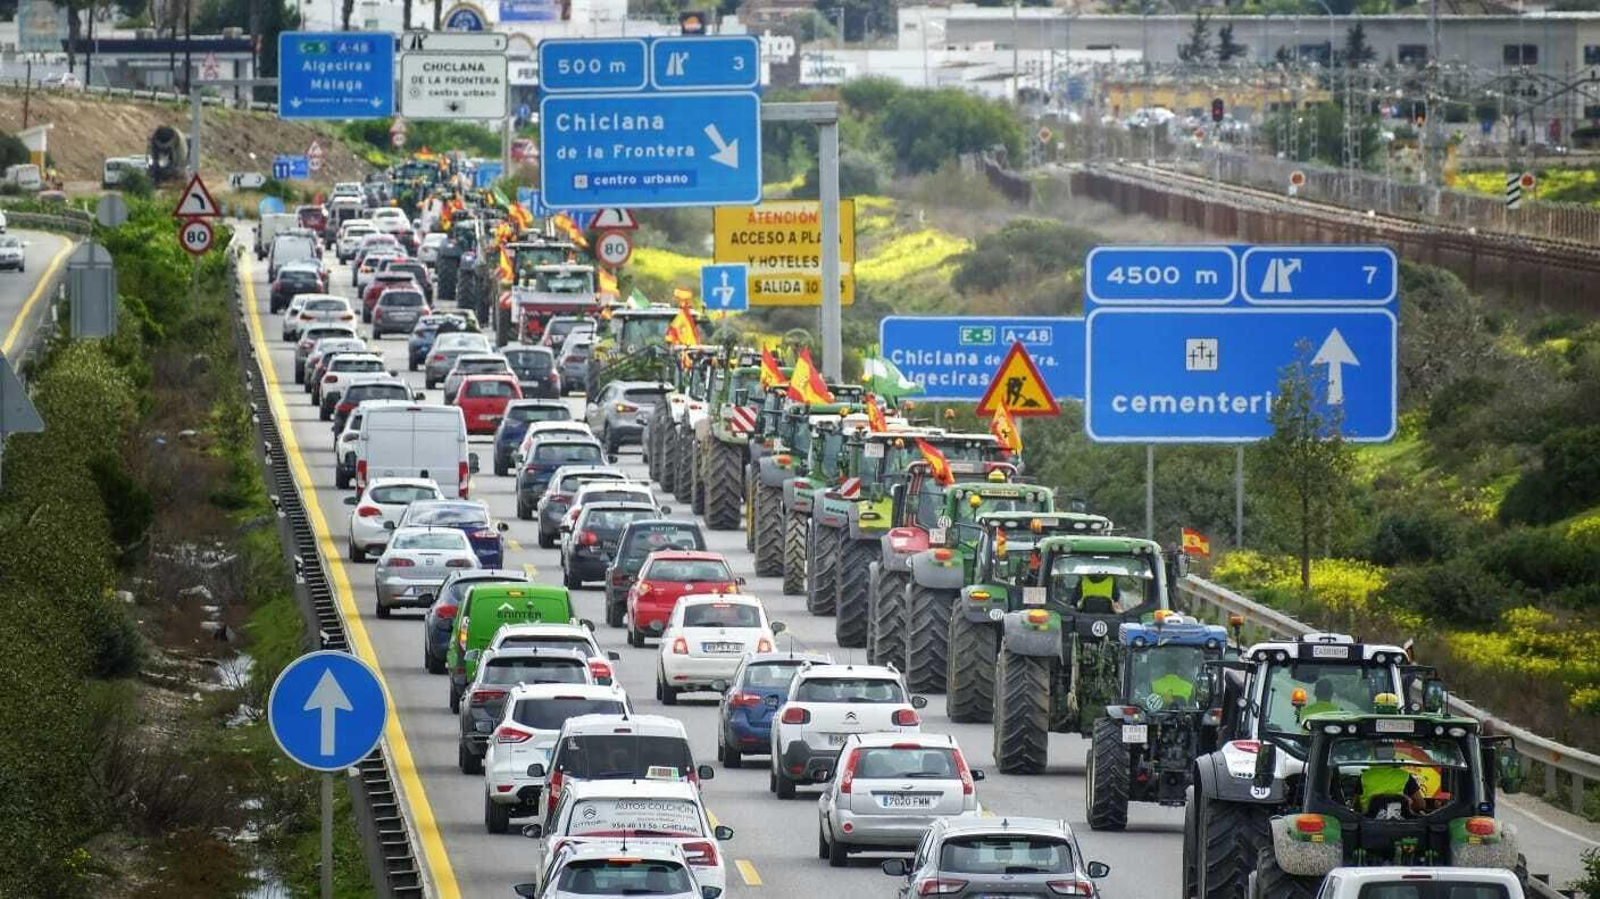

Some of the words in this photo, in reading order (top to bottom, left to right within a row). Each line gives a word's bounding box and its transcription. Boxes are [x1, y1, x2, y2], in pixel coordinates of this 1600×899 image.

[302, 60, 373, 75] Algeciras
[422, 61, 486, 72] CHICLANA
[557, 58, 601, 75] 500
[609, 60, 626, 74] m
[732, 56, 745, 71] 3
[310, 78, 363, 93] Málaga
[411, 75, 425, 84] DE
[428, 75, 441, 84] LA
[445, 75, 500, 85] FRONTERA
[428, 88, 459, 97] centro
[462, 88, 497, 97] urbano
[556, 112, 664, 132] Chiclana
[556, 146, 577, 160] de
[587, 145, 604, 159] la
[613, 144, 695, 160] Frontera
[593, 173, 637, 185] centro
[643, 172, 689, 185] urbano
[747, 207, 819, 225] ATENCIÓN
[187, 231, 208, 243] 80
[731, 231, 785, 245] ACCESO
[788, 231, 797, 244] A
[604, 243, 626, 256] 80
[748, 256, 756, 268] Y
[759, 255, 819, 268] HOTELES
[1107, 266, 1180, 284] 4500
[1195, 268, 1218, 284] m
[1362, 266, 1378, 285] 7
[754, 279, 801, 293] SALIDA
[962, 329, 993, 342] E-5
[1005, 329, 1049, 342] A-48
[891, 350, 979, 366] Chiclana
[984, 354, 1000, 366] de
[1093, 622, 1107, 635] 40
[615, 800, 645, 810] AUTOS
[889, 796, 911, 805] 7020
